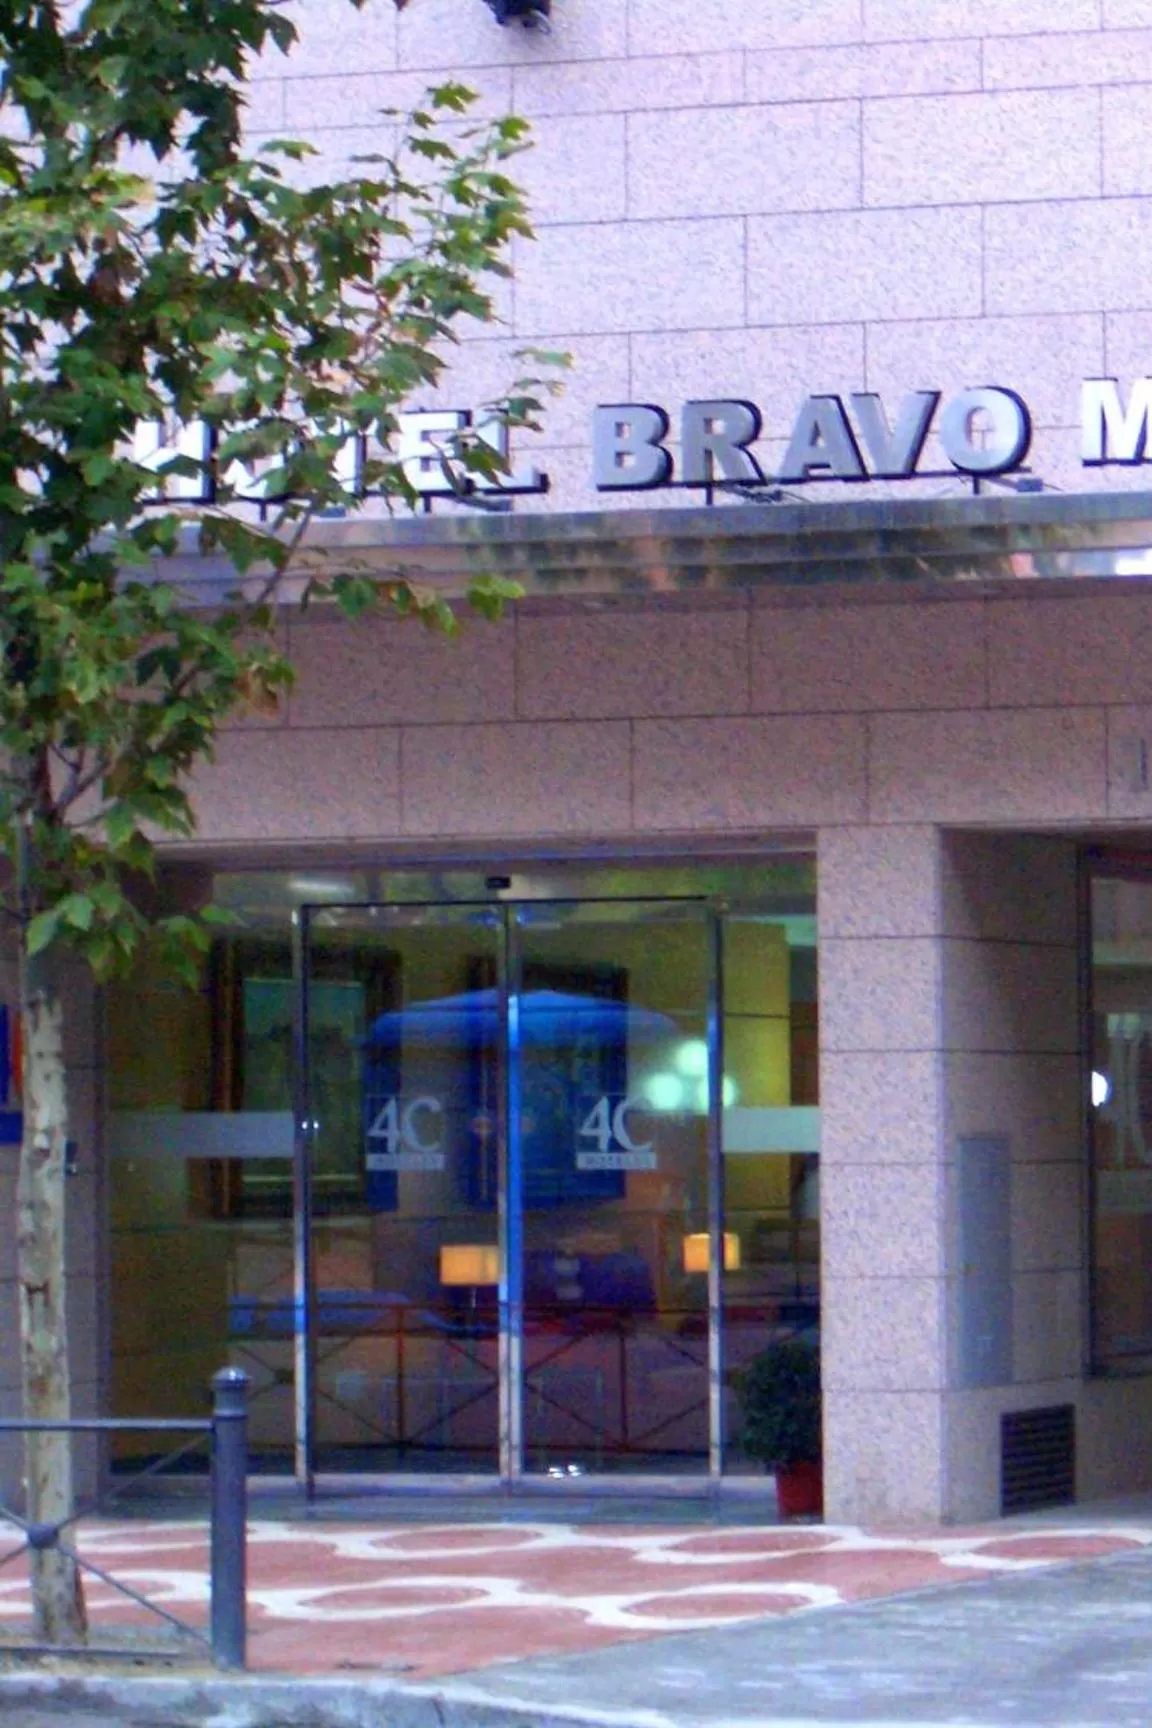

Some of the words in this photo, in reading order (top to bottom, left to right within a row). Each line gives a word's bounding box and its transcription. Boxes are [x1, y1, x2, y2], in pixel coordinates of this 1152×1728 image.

[594, 384, 1032, 491] BRAVO
[366, 1096, 442, 1152] 4C
[579, 1095, 652, 1152] 4C
